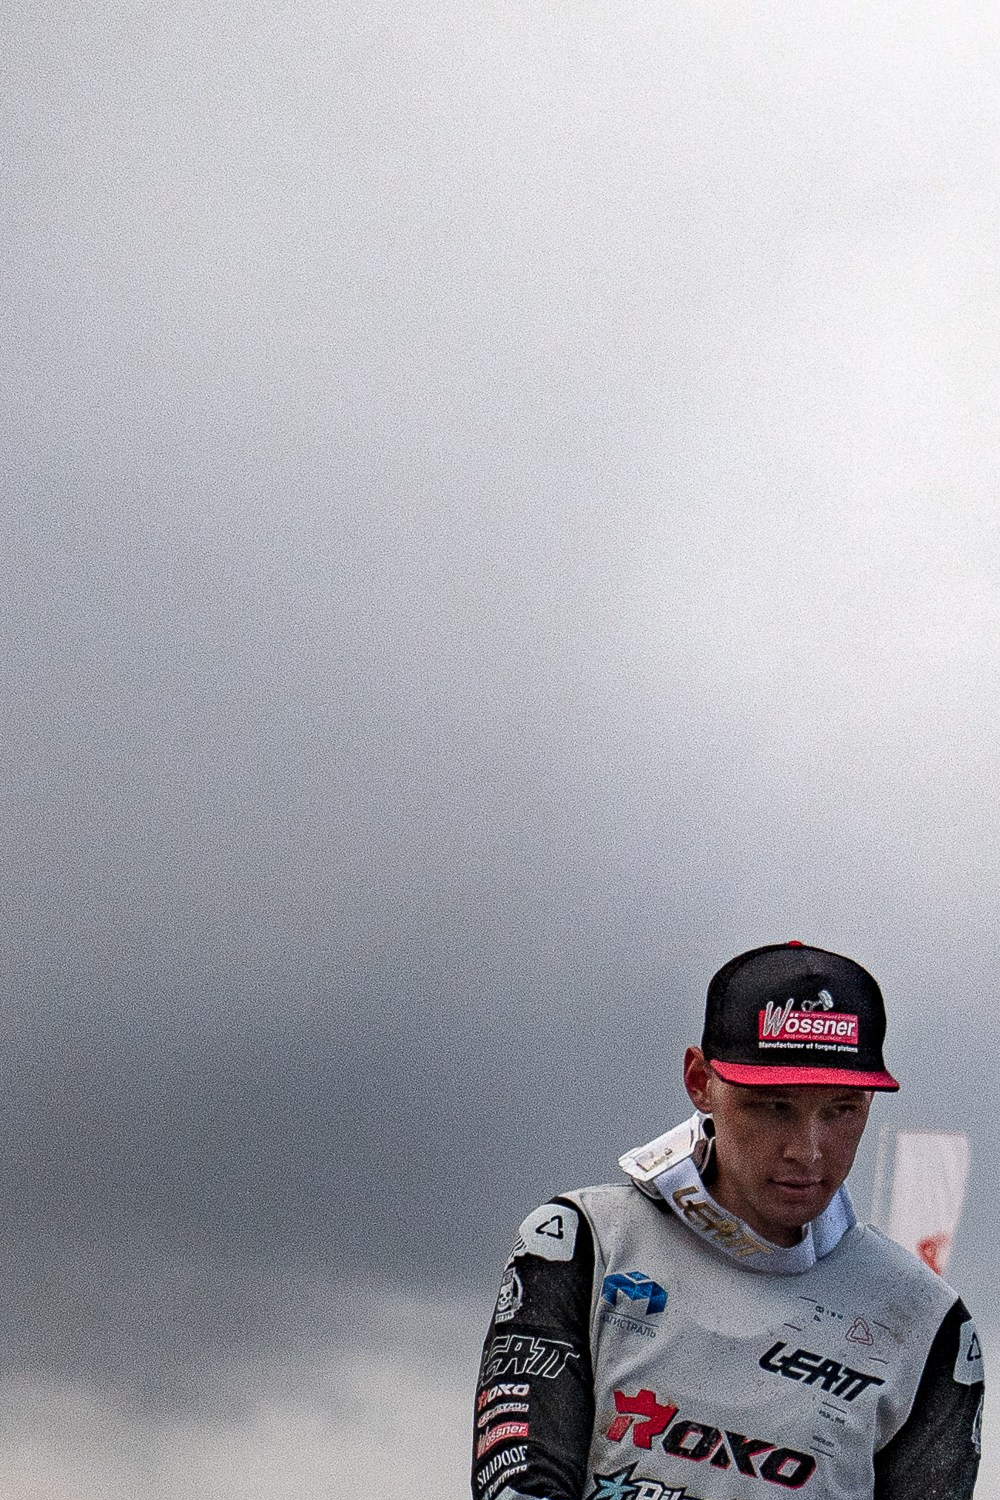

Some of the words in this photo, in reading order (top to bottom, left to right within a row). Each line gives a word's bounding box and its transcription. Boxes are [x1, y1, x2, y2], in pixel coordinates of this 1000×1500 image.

[763, 998, 856, 1036] Wössner
[759, 1341, 886, 1402] LEATT
[606, 1389, 816, 1489] ROXO
